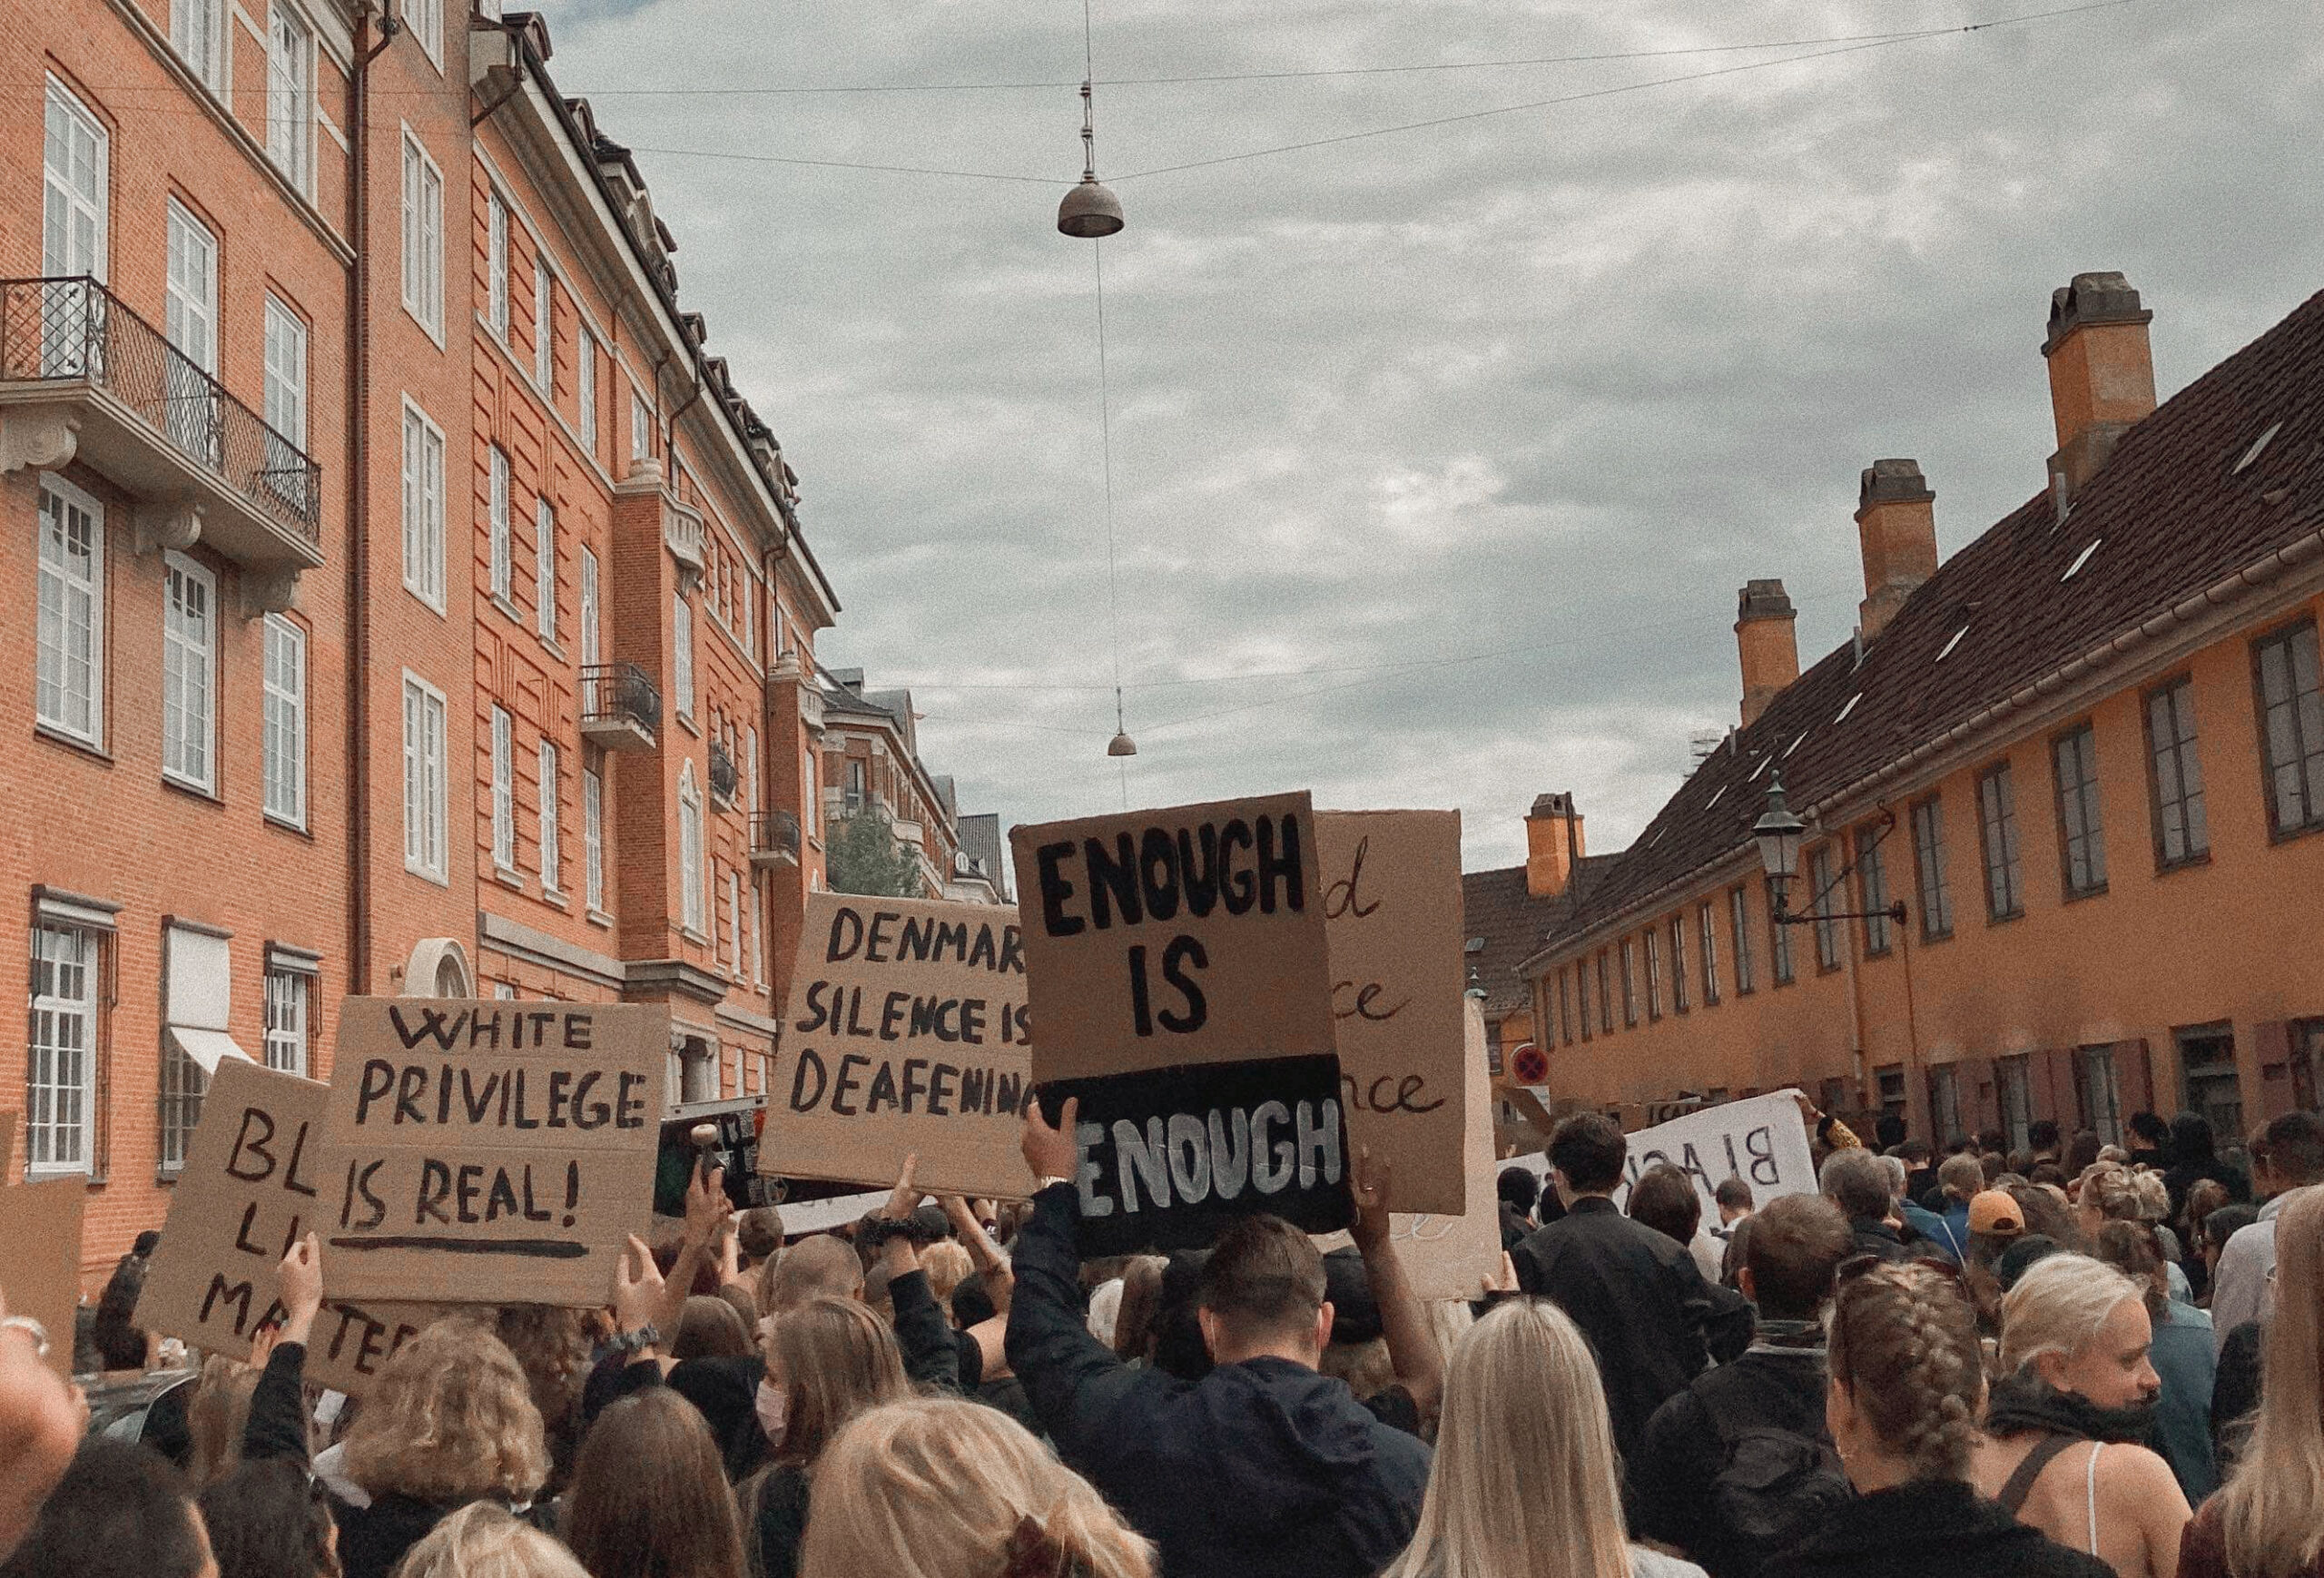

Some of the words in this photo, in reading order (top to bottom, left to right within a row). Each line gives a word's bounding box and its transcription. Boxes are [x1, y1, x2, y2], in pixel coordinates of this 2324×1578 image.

[1036, 814, 1305, 937] ENOUGH
[826, 907, 1026, 974] DENMAR
[795, 980, 987, 1045] SILENCE
[1001, 1001, 1032, 1046] IS
[1128, 934, 1209, 1037] IS
[389, 1005, 593, 1050] WHITE
[355, 1059, 647, 1129] PRIVILEGE
[340, 1158, 386, 1231] IS
[415, 1158, 580, 1228] REAL!
[1076, 1099, 1342, 1217] ENOUGH
[199, 1272, 419, 1376] MATE
